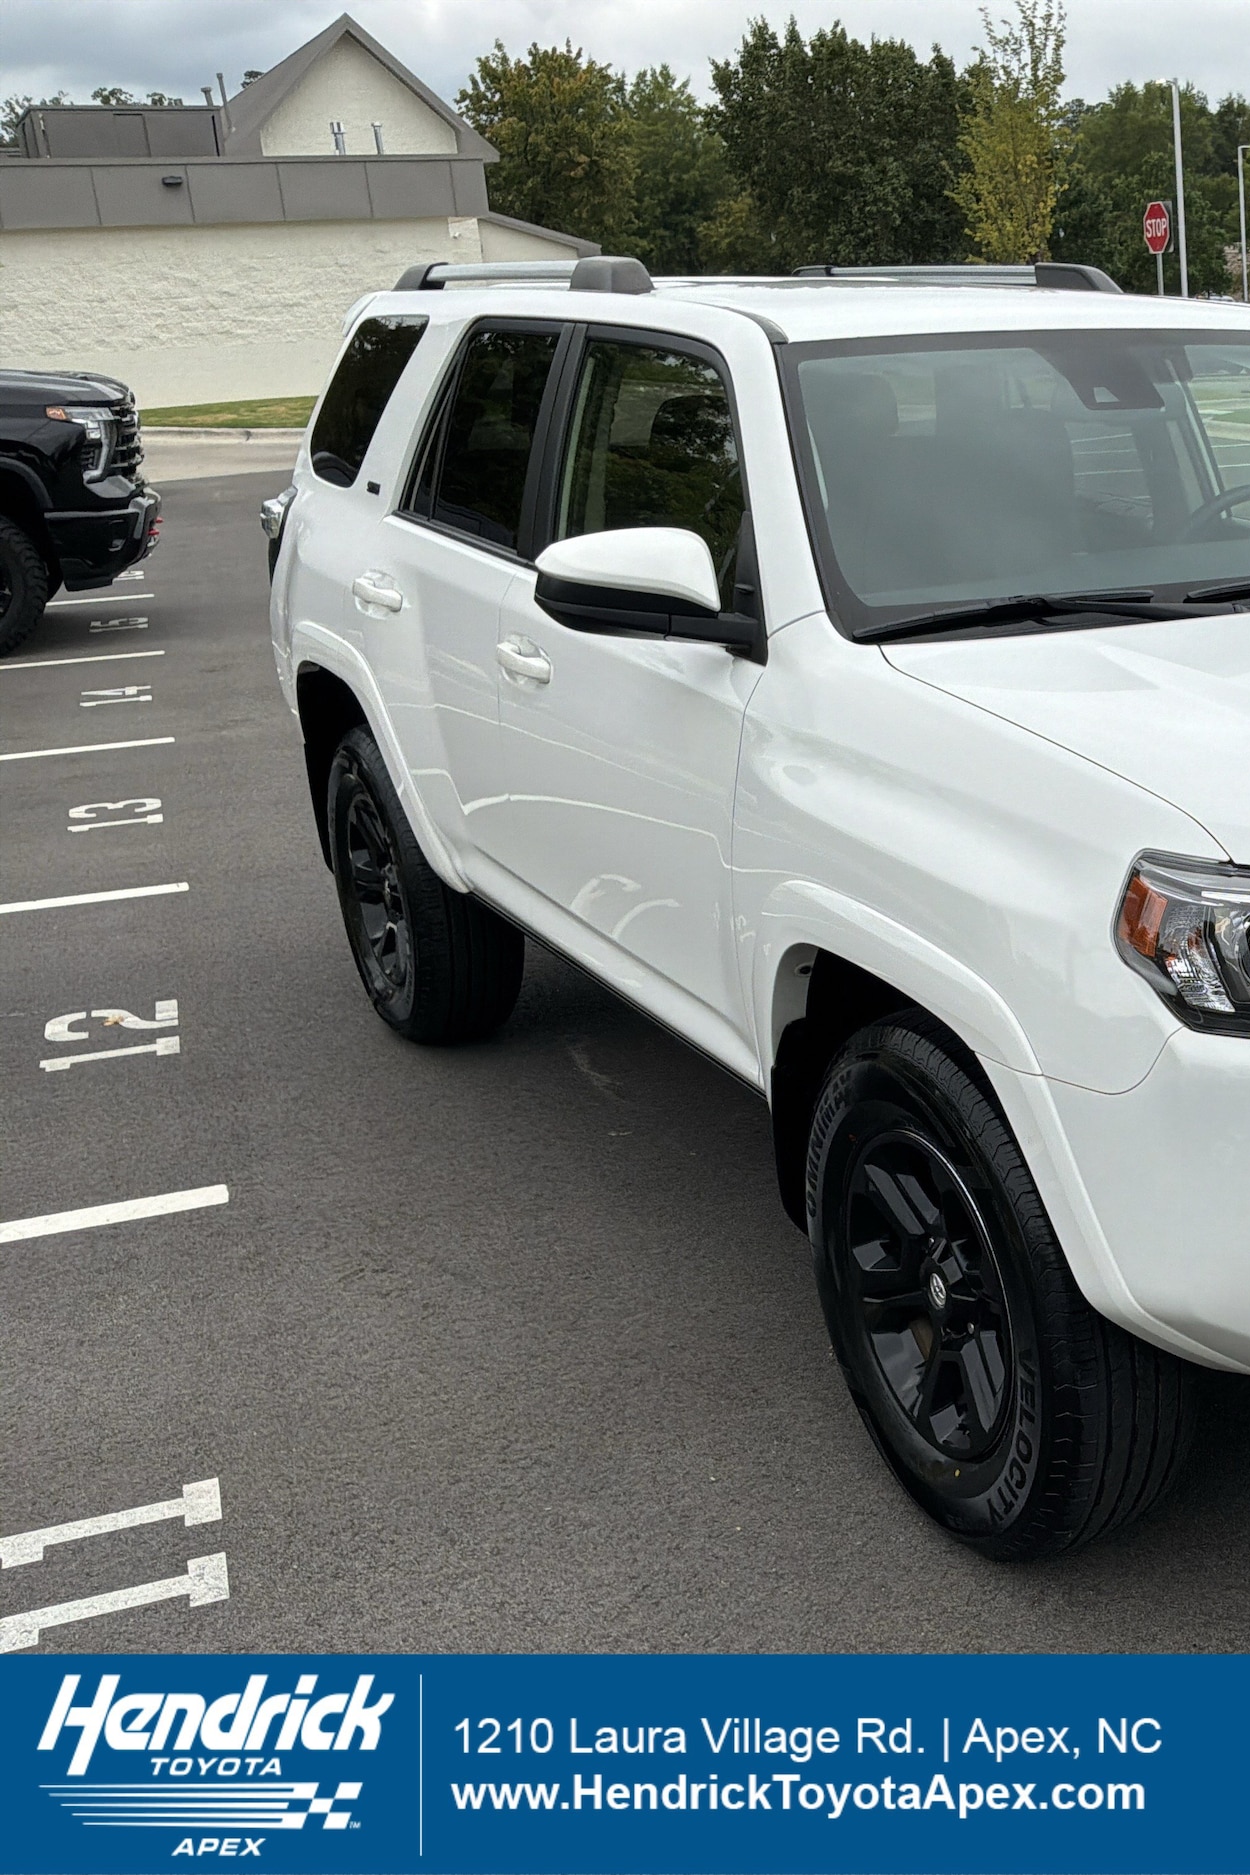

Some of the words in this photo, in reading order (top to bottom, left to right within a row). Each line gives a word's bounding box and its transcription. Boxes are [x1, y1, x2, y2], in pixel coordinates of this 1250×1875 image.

[1146, 218, 1167, 238] STOP
[67, 797, 164, 833] 13
[39, 999, 181, 1072] 12
[985, 1346, 1037, 1523] VELOCITY
